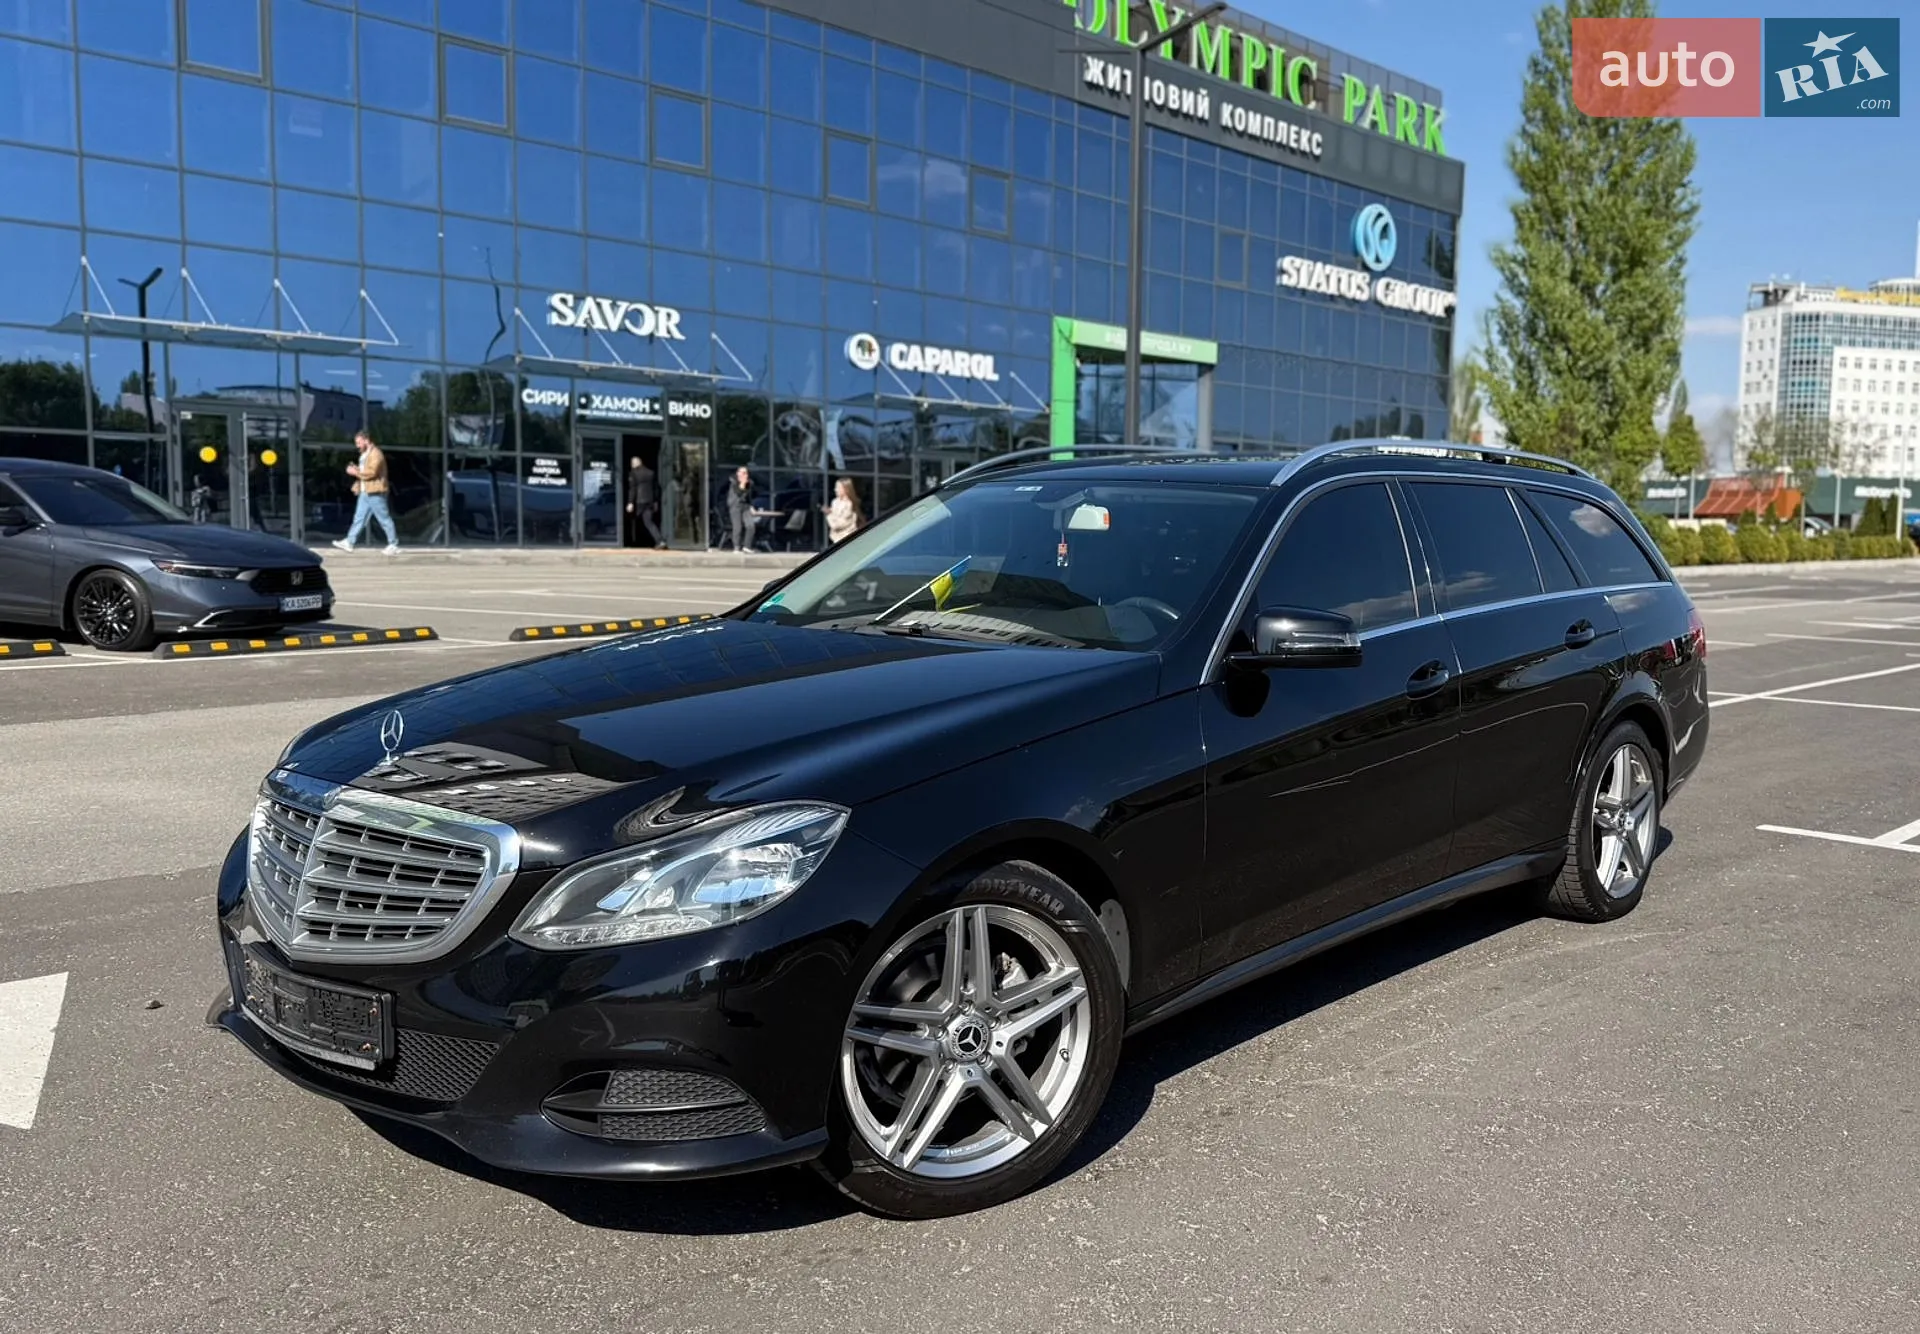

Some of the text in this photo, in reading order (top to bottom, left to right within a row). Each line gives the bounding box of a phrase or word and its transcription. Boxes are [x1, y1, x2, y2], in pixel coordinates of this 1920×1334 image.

[1220, 102, 1323, 157] КОМПЛЕКС
[1342, 73, 1448, 157] PARK
[1277, 256, 1457, 318] STATUS GROUP
[547, 292, 686, 340] SAVOR
[887, 342, 999, 381] CAPAROL
[522, 388, 569, 407] СИРИ
[591, 394, 650, 413] ХАМОН
[668, 401, 711, 419] ВИНО
